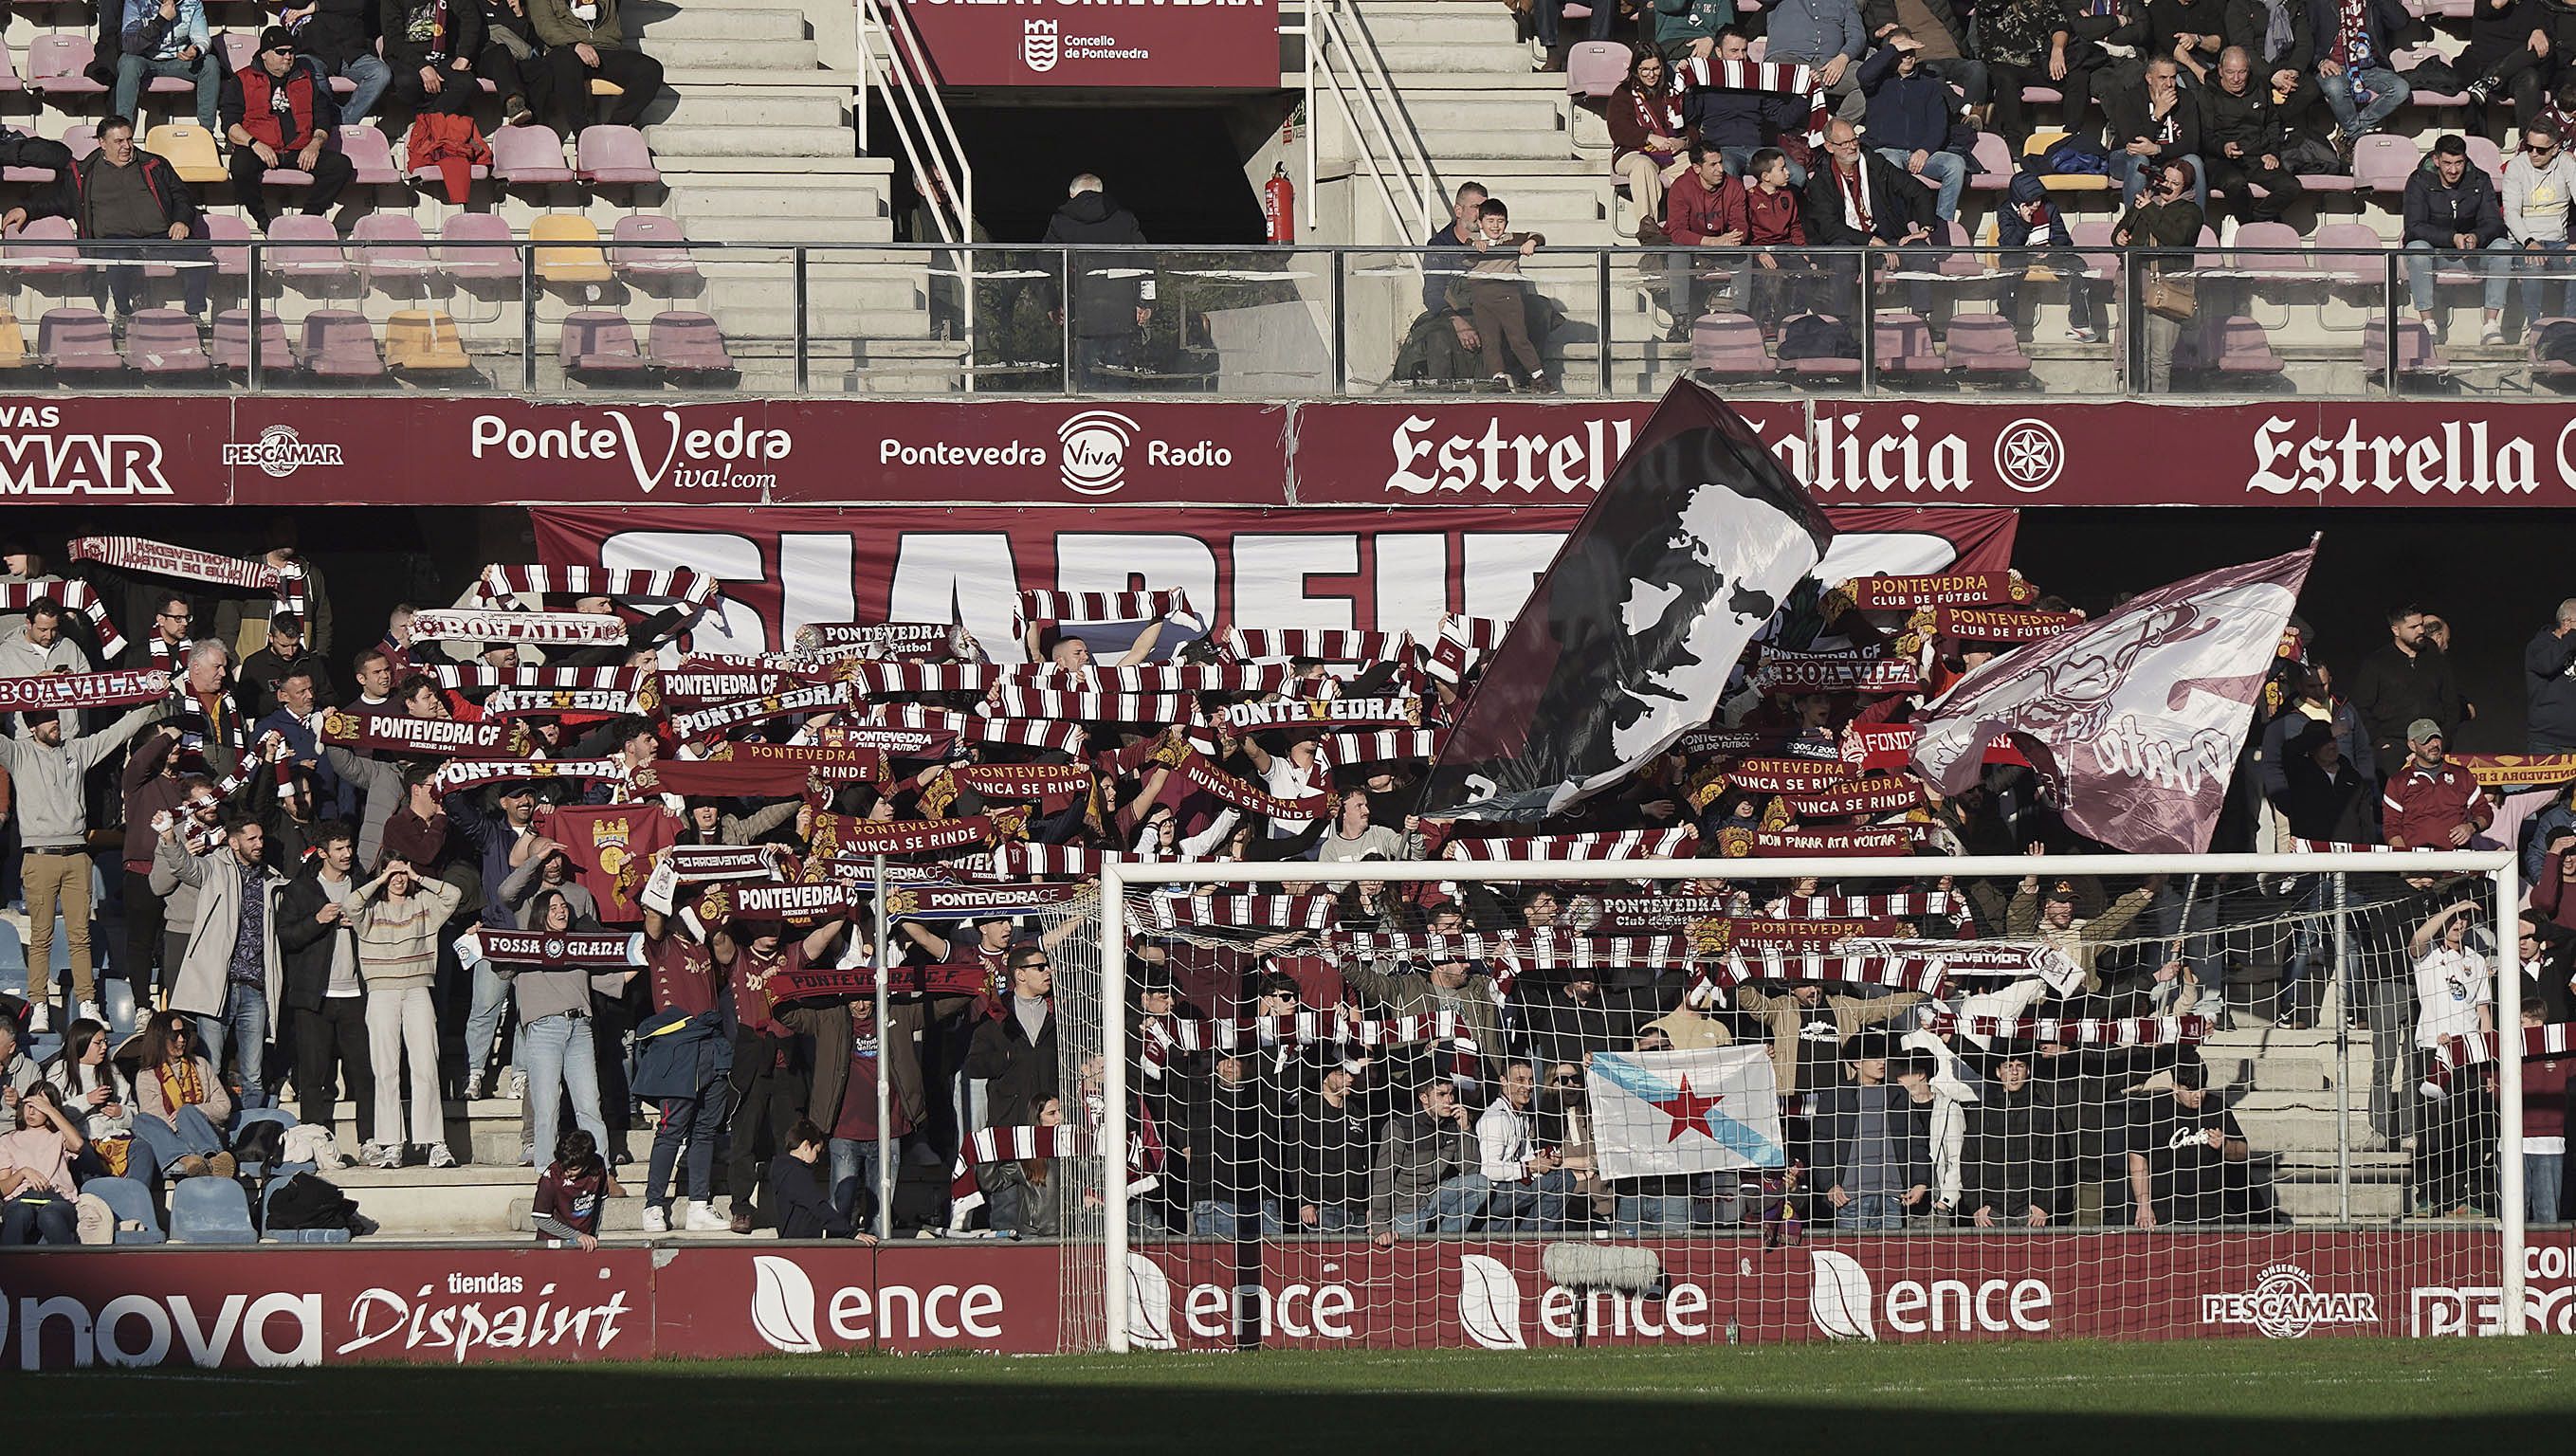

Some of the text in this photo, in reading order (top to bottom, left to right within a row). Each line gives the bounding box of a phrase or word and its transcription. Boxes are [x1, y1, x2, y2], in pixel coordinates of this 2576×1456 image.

[1064, 34, 1115, 46] Concello
[1064, 47, 1149, 60] de Pontevedra
[223, 444, 344, 465] PESCAMAR
[880, 439, 1233, 467] Pontevedra Viva Radio
[1739, 413, 1974, 494] alicia
[2245, 415, 2541, 495] Estrella
[1871, 572, 1988, 595] PONTEVEDRA
[1872, 589, 1988, 606] CLUB DE FÚTBOL
[1949, 608, 2067, 626] PONTEVEDRA
[825, 625, 946, 641] PONTEVEDRA
[1951, 623, 1985, 636] CLUB
[1990, 625, 2010, 637] DE
[722, 654, 757, 667] QUE
[1776, 661, 1919, 685] BOA VILA
[0, 671, 143, 704] BOA VILA
[665, 674, 778, 696] PONTEVEDRA CF
[680, 682, 850, 738] PONTEVEDRA
[370, 716, 501, 747] PONTEVEDRA CF
[409, 740, 437, 751] DESDE
[751, 745, 857, 761] PONTEVEDRA
[892, 743, 922, 752] FUTBOL
[822, 765, 868, 779] RINDE
[969, 765, 1082, 779] PONTEVEDRA
[1021, 782, 1040, 795] SE
[1188, 766, 1314, 820] NUNCA SE RINDE
[1204, 758, 1299, 810] PONTEVEDRA
[1785, 778, 1805, 792] SE
[1845, 797, 1863, 812] SE
[1871, 790, 1917, 810] RINDE
[854, 818, 962, 836] PONTEVEDRA
[846, 827, 978, 855] NUNCA SE RINDE
[1758, 833, 1781, 847] NON
[1784, 833, 1823, 849] PARAR
[1827, 832, 1850, 849] ATA
[1853, 830, 1897, 848] VOLTAR
[739, 885, 843, 911] PONTEVEDRA
[1603, 896, 1723, 916] PONTEVEDRA
[781, 907, 810, 917] DESDE
[1616, 915, 1645, 927] Club
[1751, 921, 1866, 936] PONTEVEDRA
[488, 937, 625, 957] FOSSA GRANA
[1801, 939, 1821, 952] SE
[447, 1272, 523, 1295] tiendas
[2255, 1264, 2311, 1283] CONSERVAS
[829, 1283, 1004, 1338] ence
[1184, 1283, 1356, 1338] ence
[1540, 1283, 1708, 1338] ence
[1886, 1279, 2053, 1333] ence
[2202, 1292, 2379, 1324] PESCAMAR
[336, 1283, 632, 1364] Dispaint
